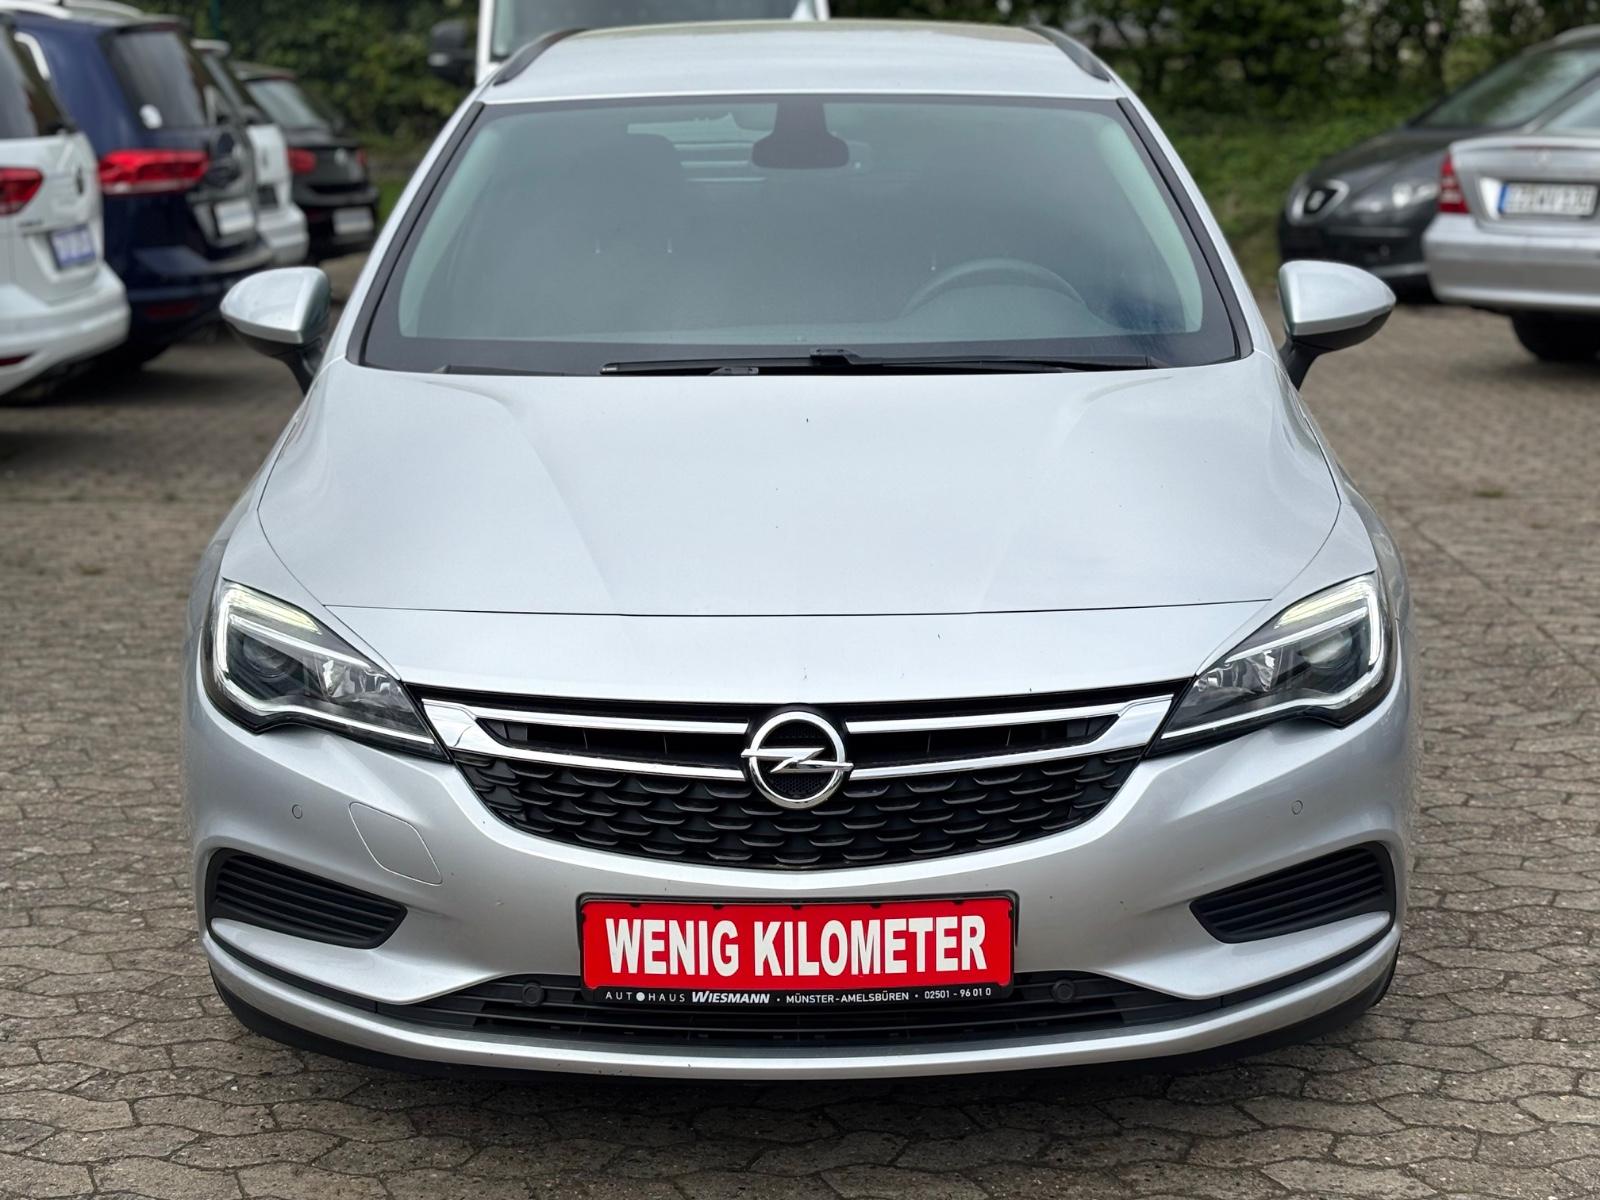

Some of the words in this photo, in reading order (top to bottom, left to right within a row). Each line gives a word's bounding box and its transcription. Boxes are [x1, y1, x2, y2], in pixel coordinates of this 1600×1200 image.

[605, 917, 739, 977] WENIG
[754, 915, 988, 977] KILOMETER
[786, 990, 909, 1004] MÜNSTER-AMELSBÜREN
[924, 989, 950, 999] 02501
[960, 988, 971, 998] 96
[972, 988, 983, 997] 01
[985, 987, 991, 996] 0
